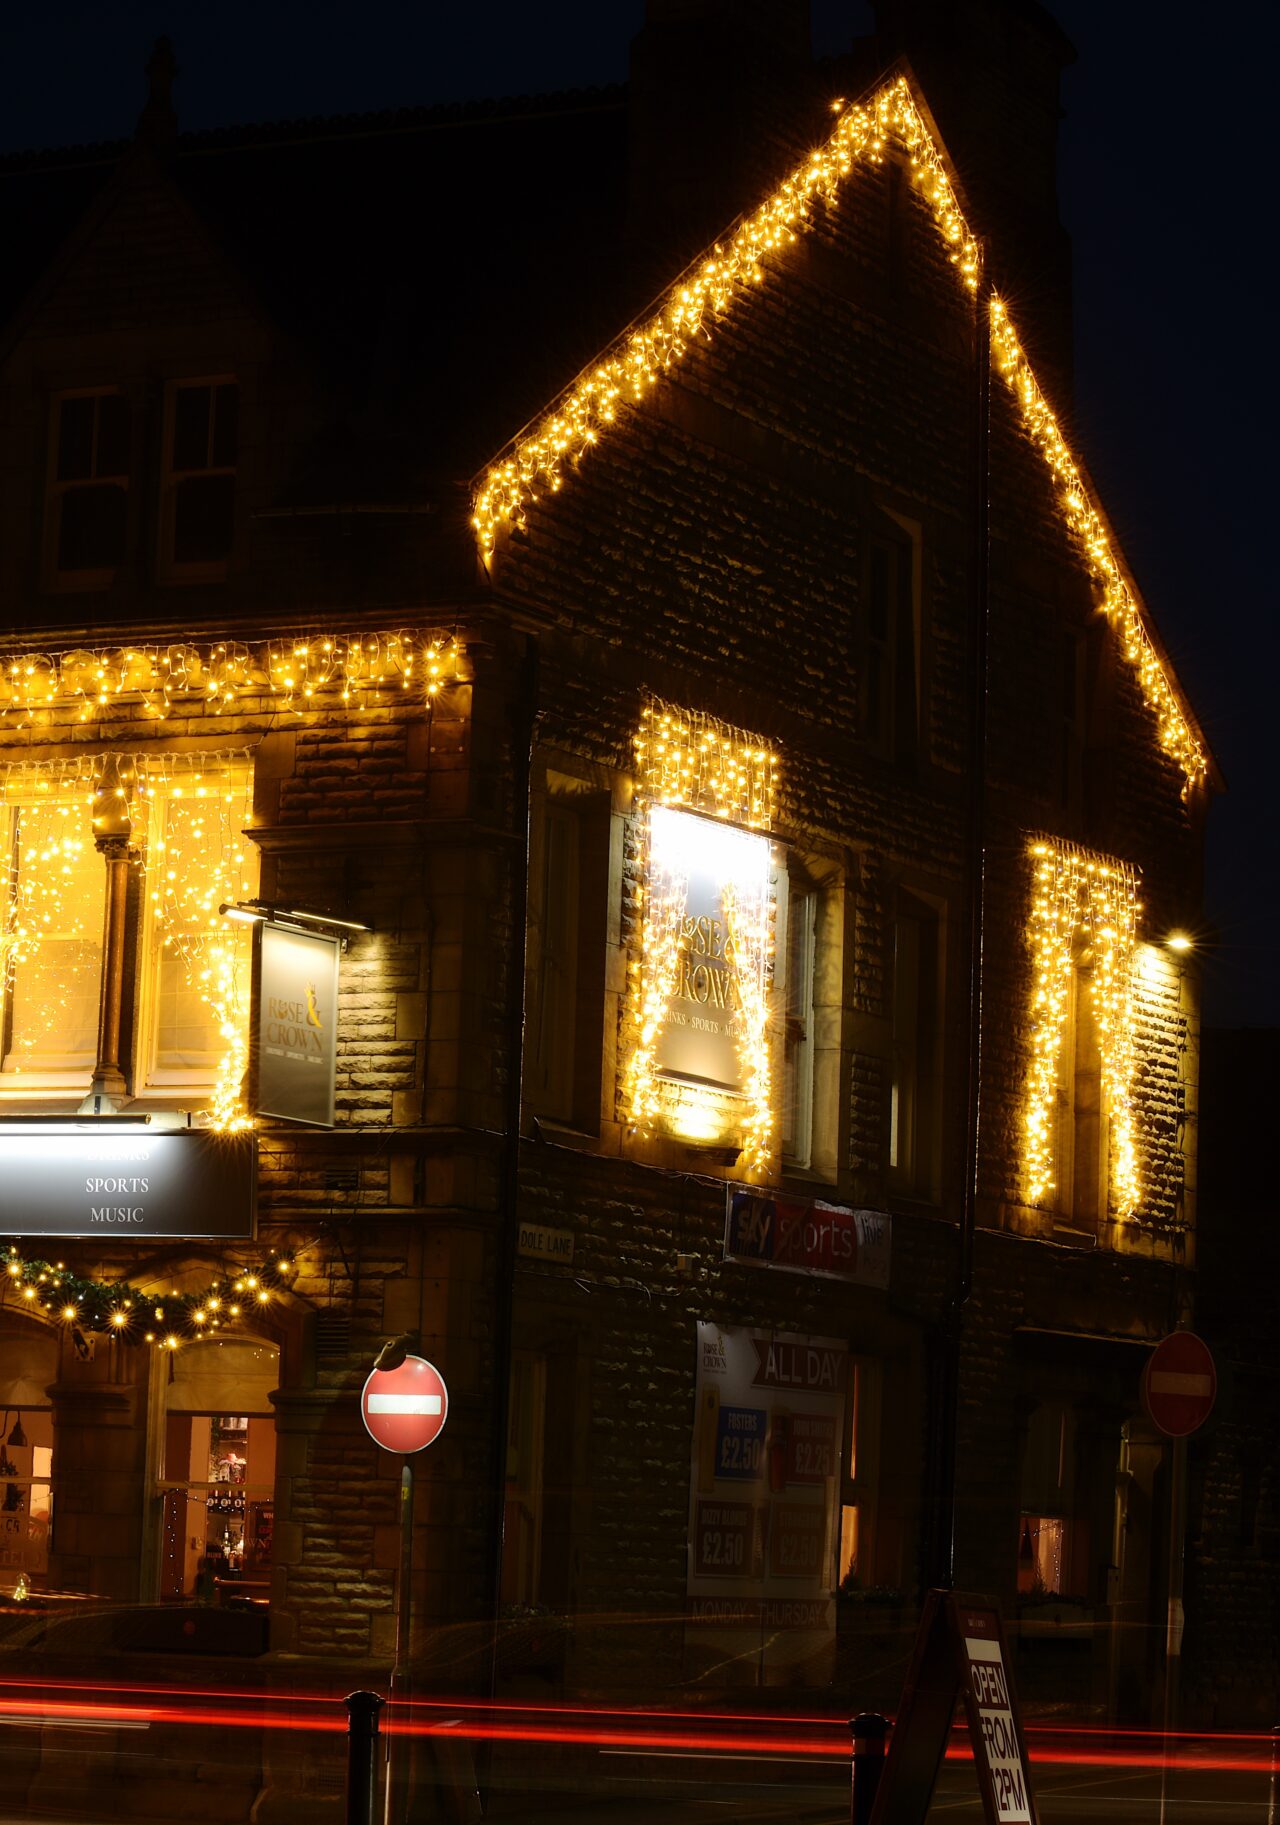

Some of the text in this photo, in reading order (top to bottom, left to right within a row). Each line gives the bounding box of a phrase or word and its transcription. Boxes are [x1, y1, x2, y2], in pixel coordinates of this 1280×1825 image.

[266, 1022, 323, 1053] CROWN
[691, 1017, 719, 1034] SPORTS
[85, 1177, 149, 1193] SPORTS
[90, 1207, 144, 1223] MUSIC
[737, 1198, 771, 1255] sky
[780, 1215, 853, 1259] sports
[547, 1235, 571, 1256] LANE
[765, 1344, 843, 1386] ALL DAY
[728, 1412, 758, 1431] FOSTERS
[721, 1435, 761, 1471] £2.50
[795, 1442, 832, 1476] £2.25
[703, 1531, 744, 1567] £2.50
[780, 1533, 819, 1567] £2.50
[692, 1600, 821, 1626] MONDAY THURSDAY
[970, 1663, 1008, 1704] OPEN
[980, 1716, 1019, 1759] FROM
[990, 1767, 1027, 1811] 12PM
